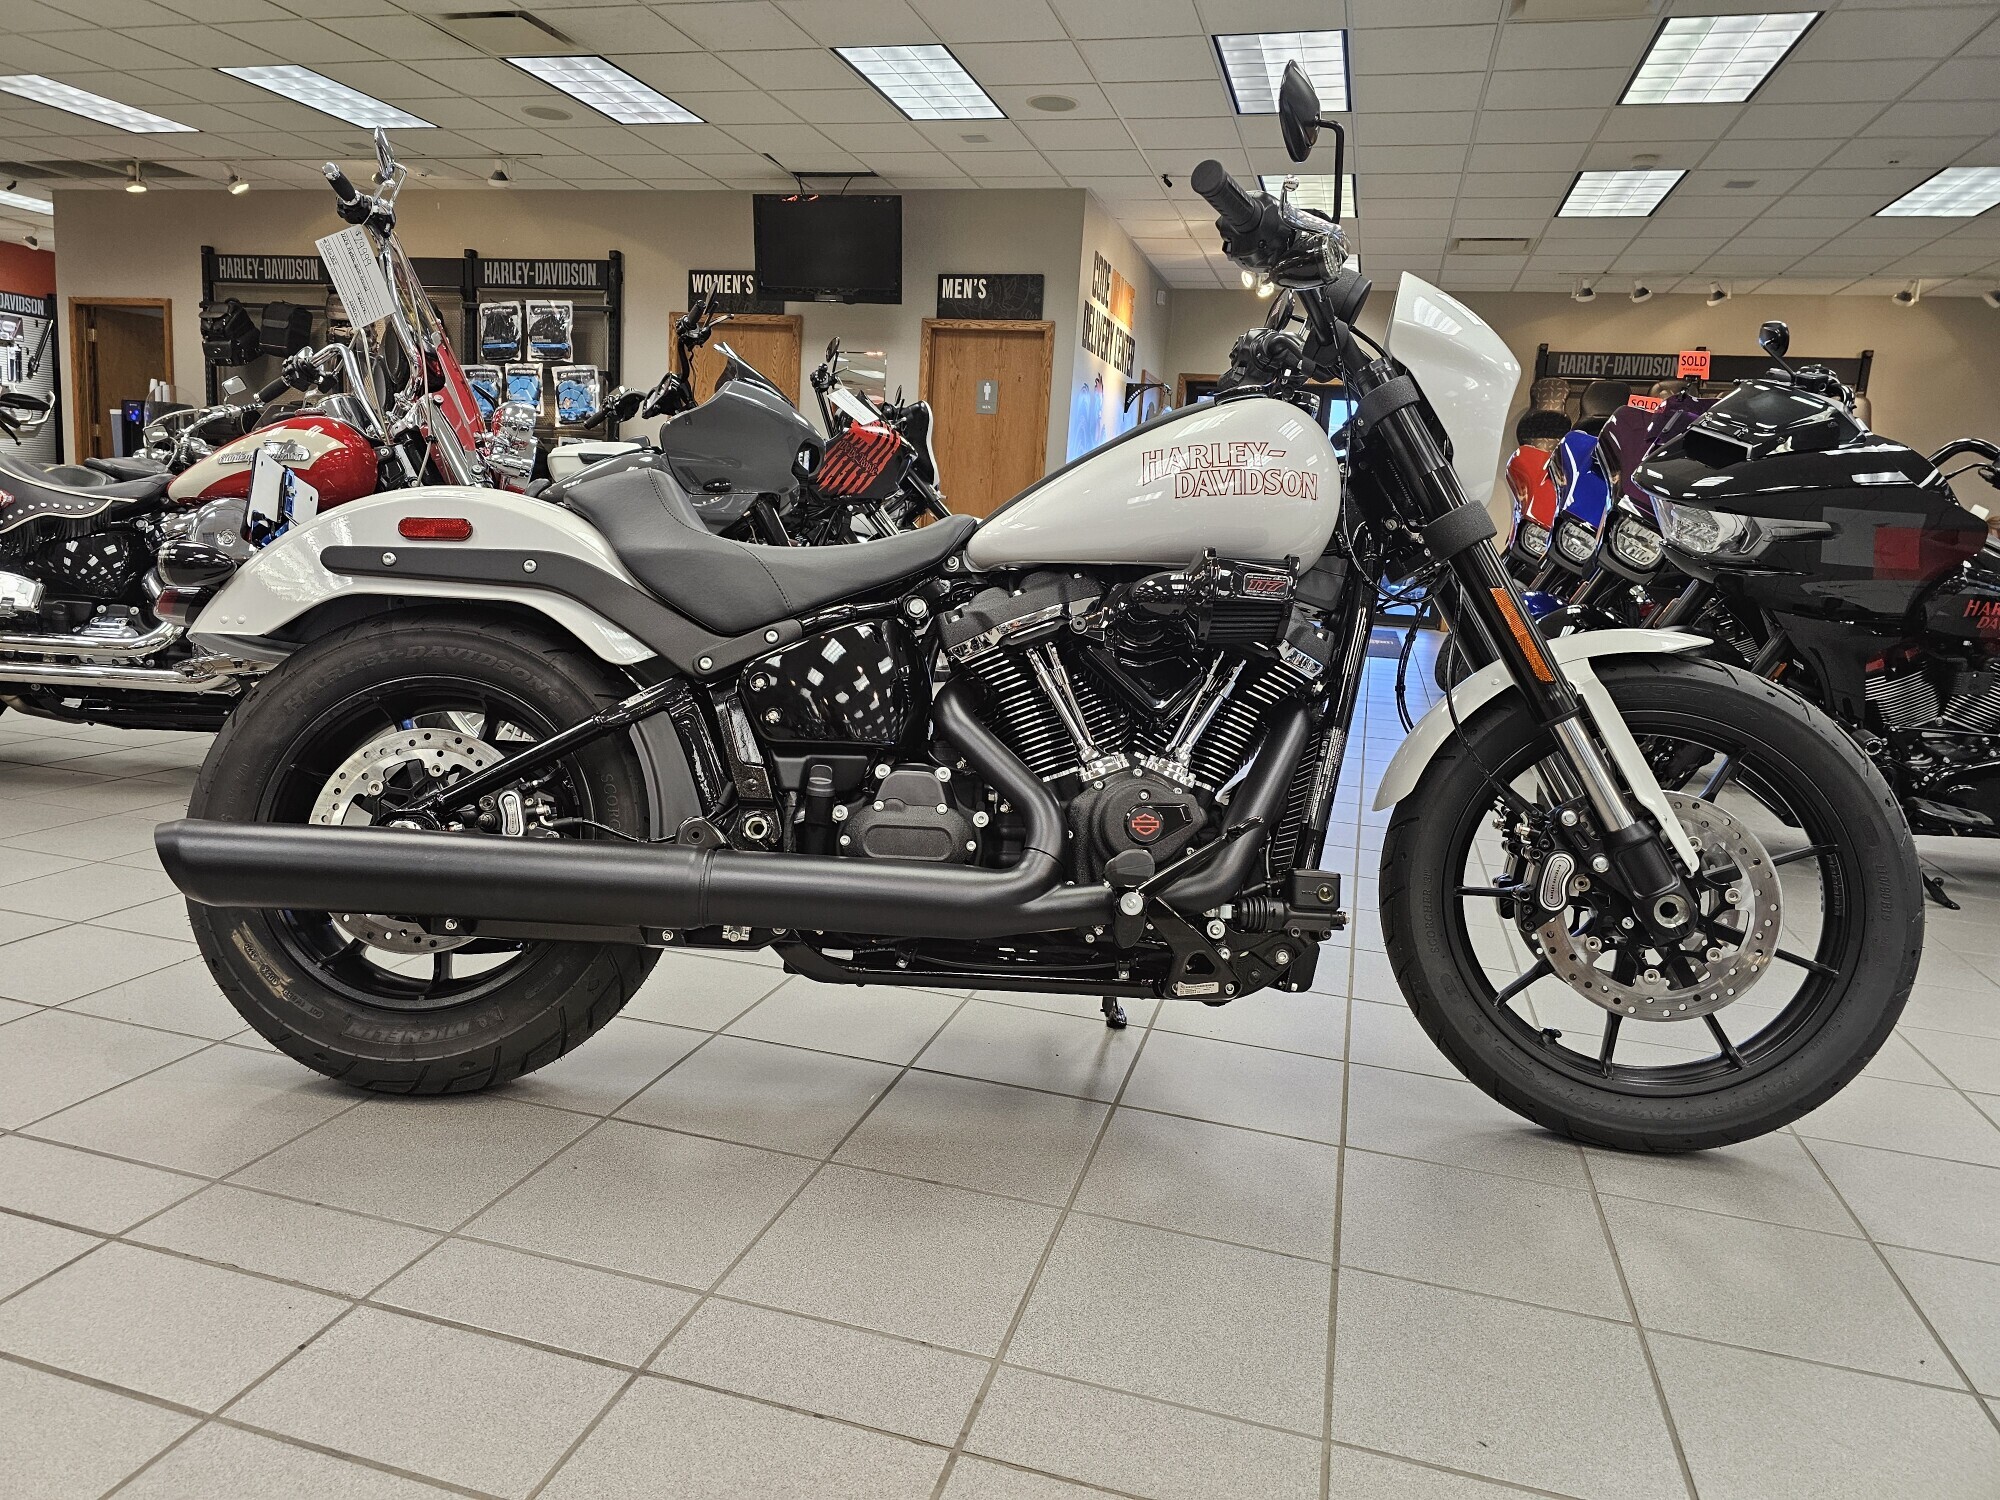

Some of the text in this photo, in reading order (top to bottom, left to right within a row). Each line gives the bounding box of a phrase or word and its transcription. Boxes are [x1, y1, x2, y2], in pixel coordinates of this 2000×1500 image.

[219, 257, 319, 281] HARLEY-DAVIDSON
[484, 262, 597, 286] HARLEY-DAVIDSON
[1092, 250, 1112, 309] CODE
[692, 274, 754, 295] WOMEN'S
[942, 277, 987, 300] MEN'S
[1081, 299, 1115, 365] DELIVERY
[1113, 326, 1136, 379] CENTER
[1681, 355, 1707, 367] SOLD
[1631, 398, 1659, 411] SOLD
[1142, 441, 1287, 486] HARLEY-
[1174, 469, 1318, 501] DAVIDSON
[1247, 579, 1287, 592] 117
